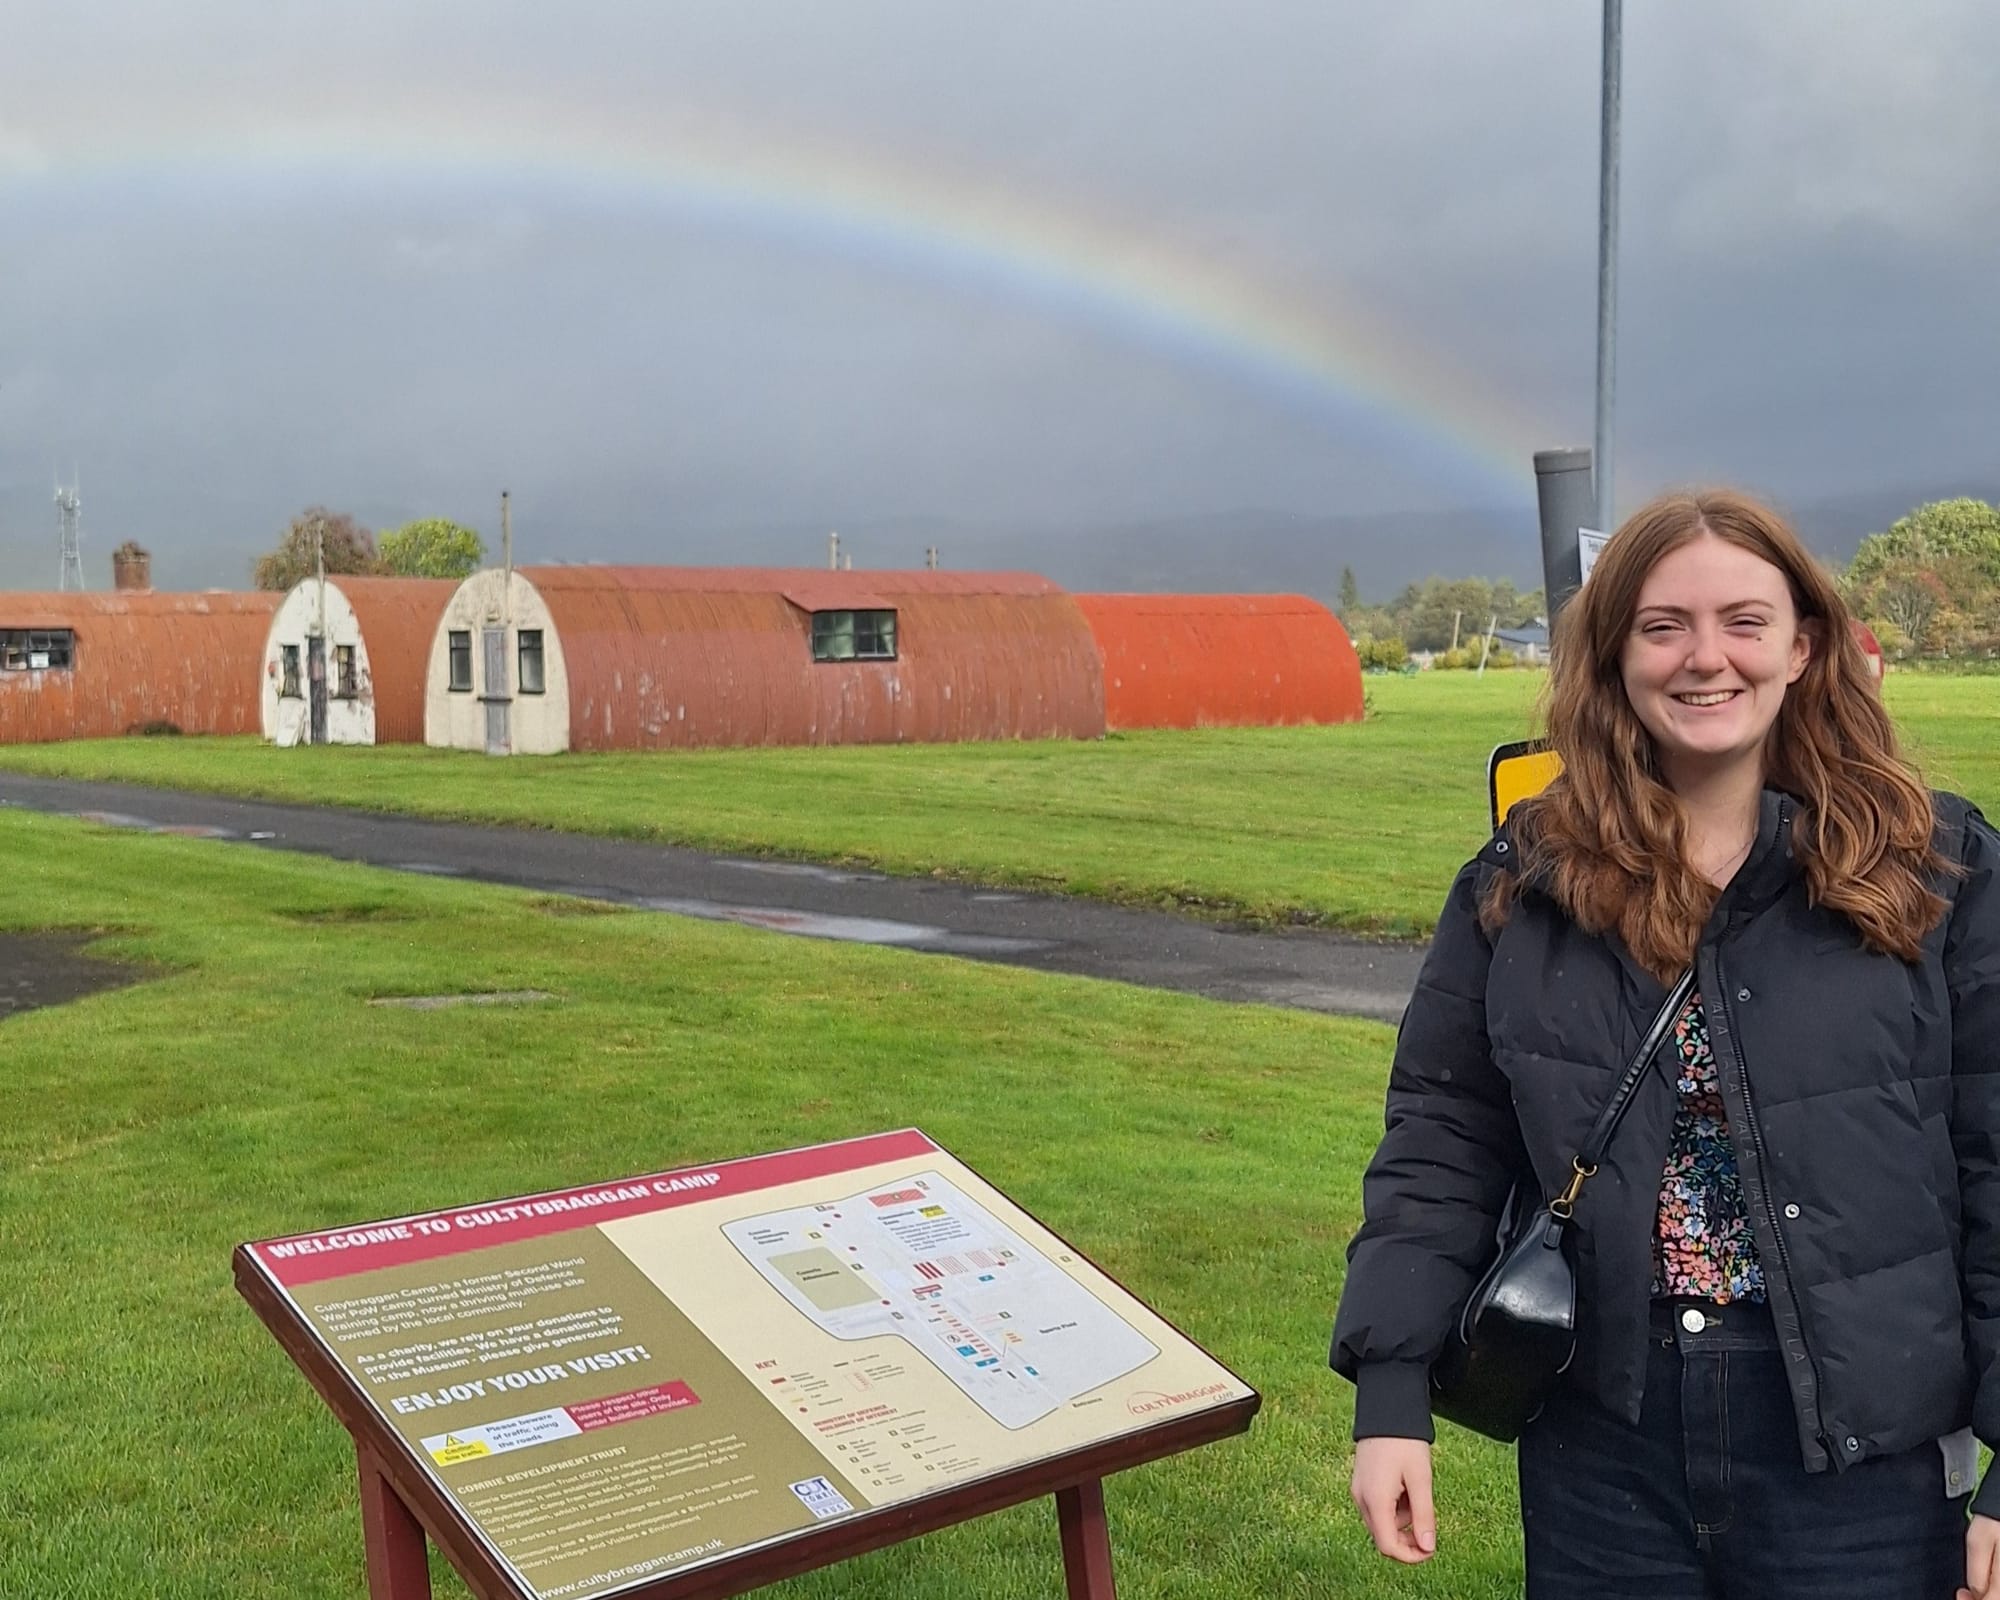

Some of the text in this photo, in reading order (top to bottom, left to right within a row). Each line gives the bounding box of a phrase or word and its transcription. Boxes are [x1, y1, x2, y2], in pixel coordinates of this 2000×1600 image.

[266, 1171, 726, 1260] WELCOME TO CULTYBRAGGAN CAMP
[312, 1291, 400, 1314] Cultybraggan
[399, 1284, 439, 1298] Camp
[438, 1282, 451, 1290] is
[462, 1272, 503, 1285] former
[503, 1263, 550, 1277] Second
[548, 1256, 586, 1268] World
[320, 1311, 348, 1322] War
[348, 1305, 379, 1317] PoW
[380, 1299, 418, 1312] camp
[417, 1291, 459, 1304] turned
[459, 1281, 511, 1297] Ministry
[524, 1269, 575, 1283] Defence
[328, 1317, 380, 1333] training
[379, 1310, 420, 1323] camp,
[420, 1305, 448, 1314] now
[459, 1293, 508, 1308] thriving
[507, 1282, 563, 1297] multi-use
[562, 1277, 585, 1286] site
[336, 1327, 381, 1341] owned
[381, 1323, 401, 1334] by
[400, 1319, 423, 1328] the
[423, 1313, 455, 1324] local
[355, 1353, 375, 1363] As
[386, 1340, 438, 1358] charity,
[437, 1338, 459, 1347] we
[458, 1331, 486, 1343] rely
[505, 1322, 536, 1334] your
[534, 1308, 598, 1327] donations
[596, 1306, 613, 1314] to
[362, 1357, 416, 1374] provide
[415, 1344, 475, 1363] facilities.
[474, 1340, 498, 1350] We
[498, 1333, 531, 1345] have
[541, 1319, 599, 1336] donation
[598, 1314, 623, 1324] box
[387, 1369, 411, 1380] the
[411, 1357, 470, 1375] Museum
[477, 1346, 523, 1362] please
[521, 1340, 552, 1353] give
[550, 1325, 625, 1347] generously.
[754, 1359, 779, 1369] KEY
[389, 1344, 655, 1415] ENJOY YOUR VISIT!
[569, 1387, 660, 1413] Please respect other
[576, 1410, 602, 1420] users
[612, 1404, 629, 1412] the
[648, 1393, 674, 1404] Only
[1131, 1382, 1227, 1414] CULTYBRAGGAN
[485, 1413, 553, 1433] Please beware
[503, 1427, 531, 1438] traffic
[532, 1421, 560, 1432] using
[582, 1417, 608, 1428] enter
[606, 1407, 651, 1423] buildings
[498, 1433, 542, 1448] the roads
[456, 1446, 629, 1494] COMRIE DEVELOPMENT TRUST
[791, 1478, 831, 1496] CDT
[802, 1489, 837, 1503] COMRIE
[815, 1502, 850, 1516] TRUST
[537, 1538, 726, 1600] www.cultybraggancamp.uk
